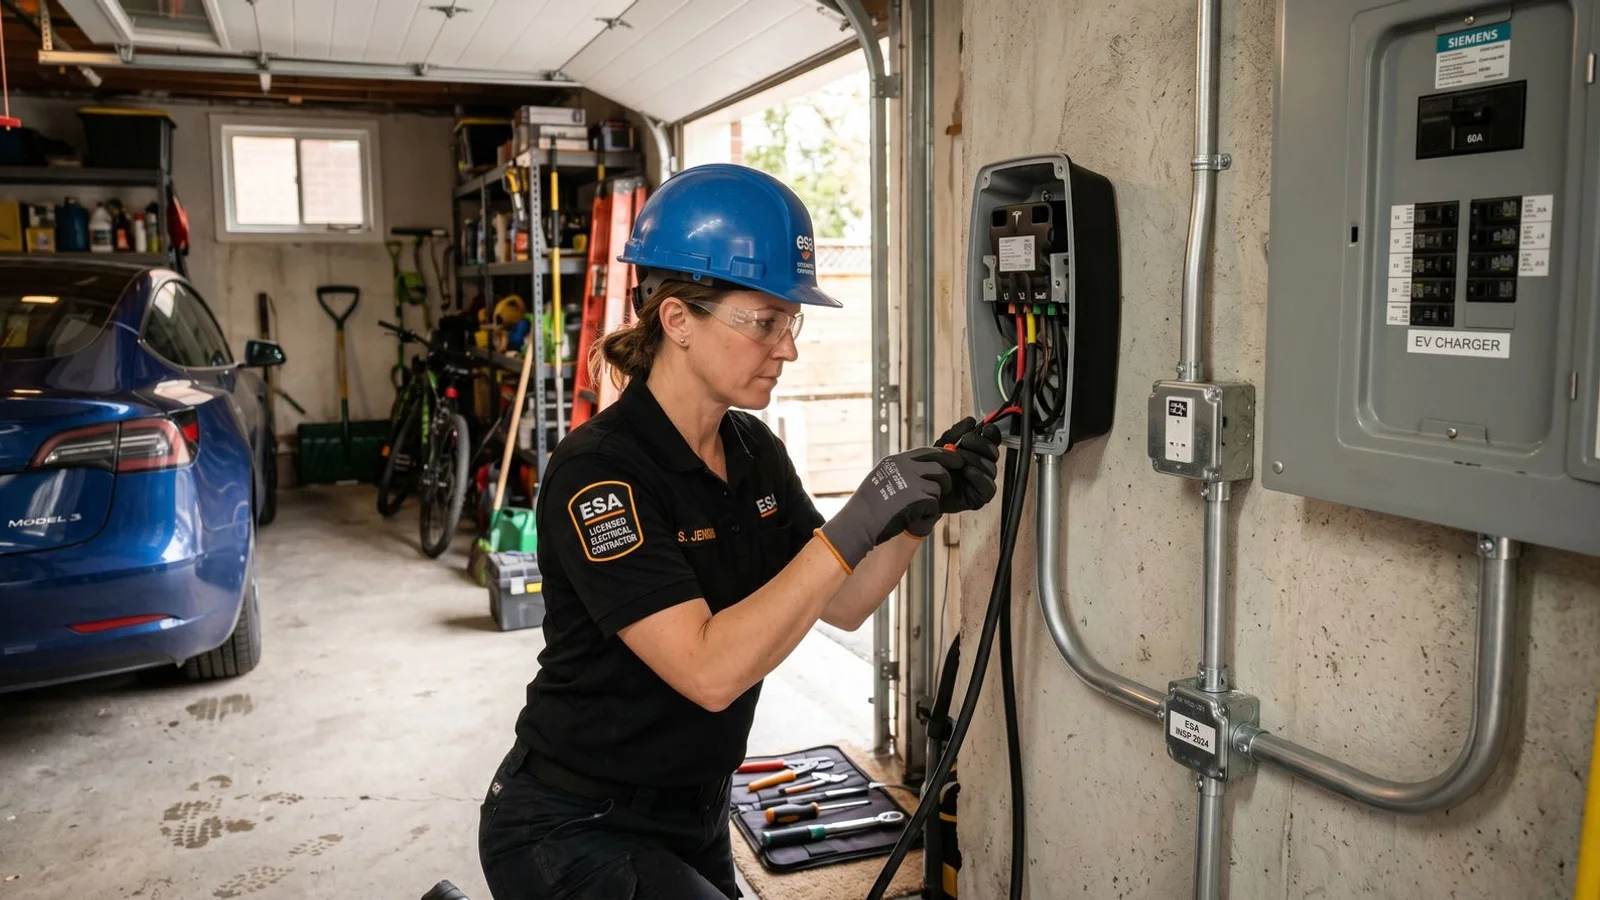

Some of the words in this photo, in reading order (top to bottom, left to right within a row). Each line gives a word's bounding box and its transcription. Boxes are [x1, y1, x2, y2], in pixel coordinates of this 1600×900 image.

[1448, 29, 1498, 48] SIEMENS
[1467, 133, 1483, 143] 60A
[797, 235, 813, 251] esa
[1415, 336, 1432, 348] EV
[1435, 336, 1500, 351] CHARGER
[579, 493, 623, 520] ESA
[756, 493, 777, 513] ESA
[8, 516, 66, 528] MODEL
[70, 513, 82, 522] 3
[589, 517, 627, 536] LICENSED
[590, 526, 633, 546] ELECTRICAL
[591, 534, 638, 555] CONTRACTOR
[677, 531, 688, 543] S.
[1184, 719, 1200, 733] ESA
[1175, 726, 1192, 738] INSP
[1193, 734, 1209, 748] 2024
